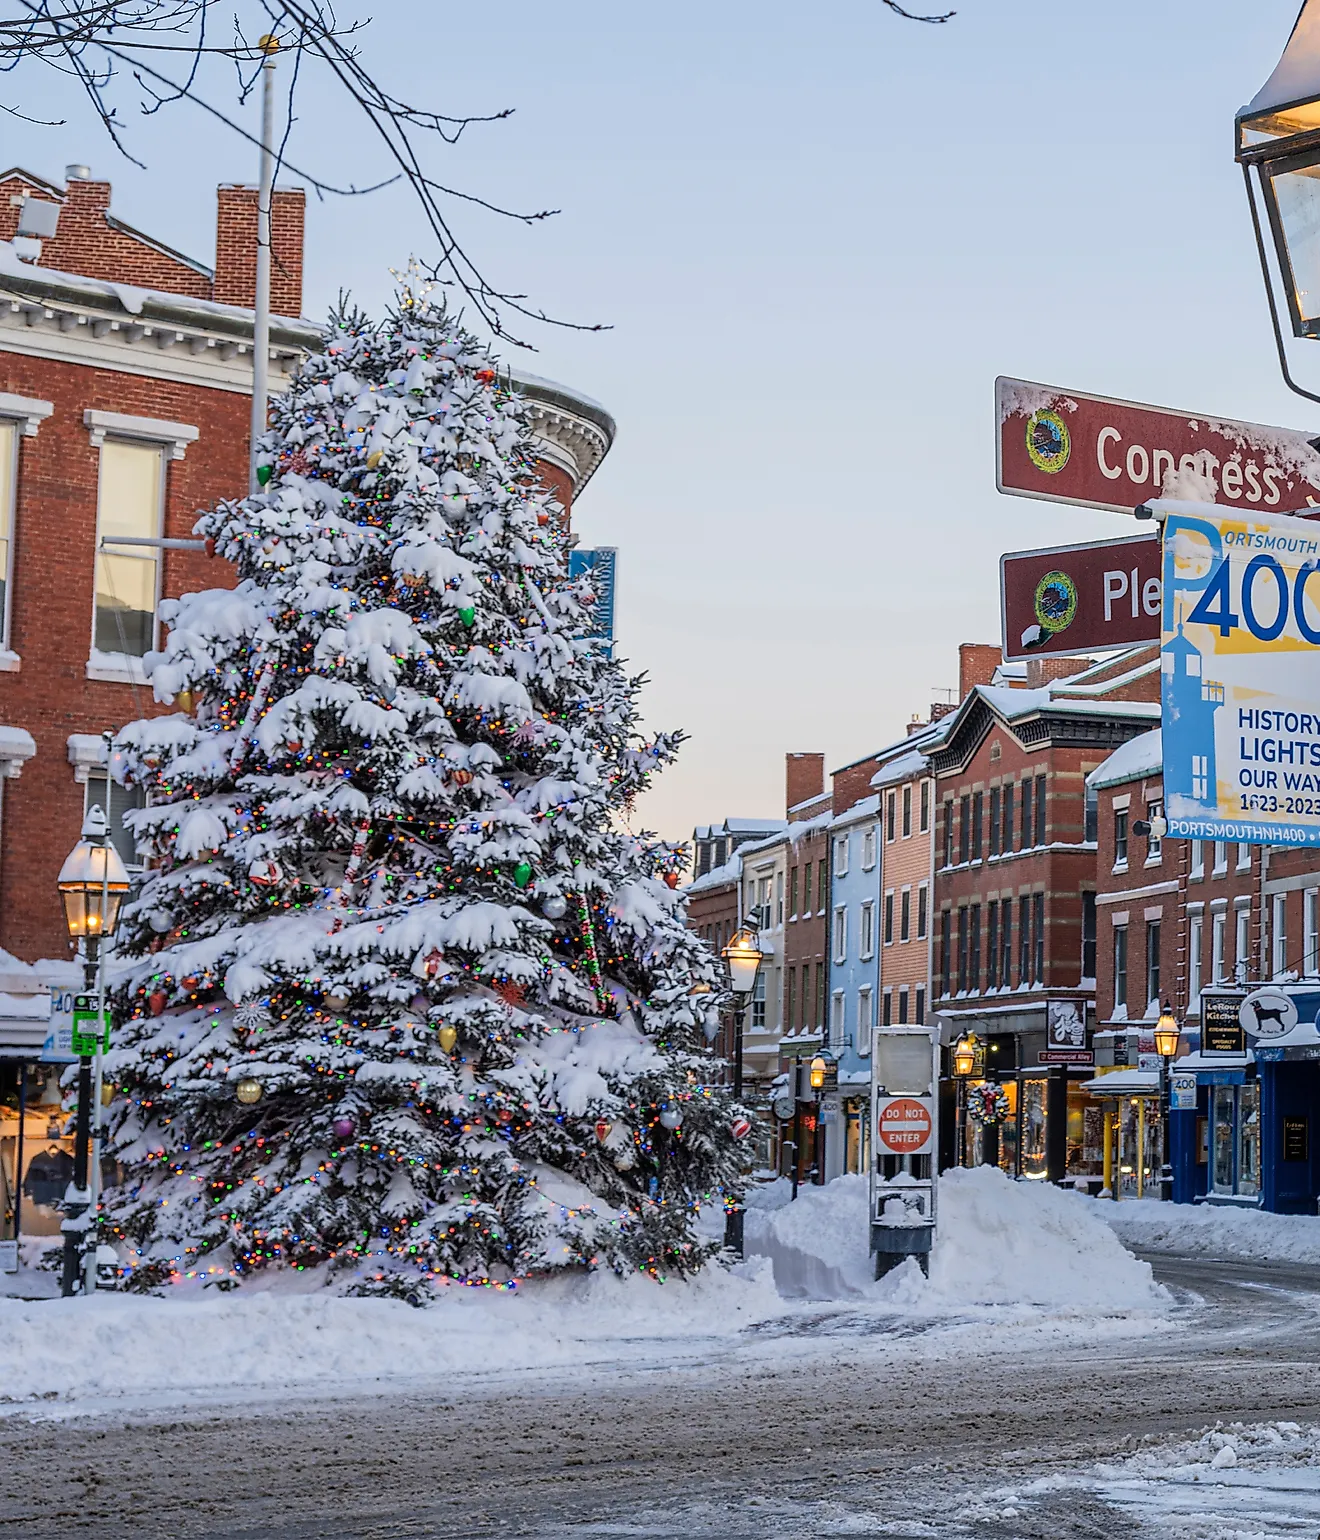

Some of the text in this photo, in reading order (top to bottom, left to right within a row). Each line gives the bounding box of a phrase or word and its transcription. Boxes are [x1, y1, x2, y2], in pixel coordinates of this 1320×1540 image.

[1239, 768, 1278, 789] OUR
[1047, 1053, 1091, 1061] Commercial Alley
[886, 1109, 925, 1119] DO NOT
[889, 1133, 920, 1143] ENTER
